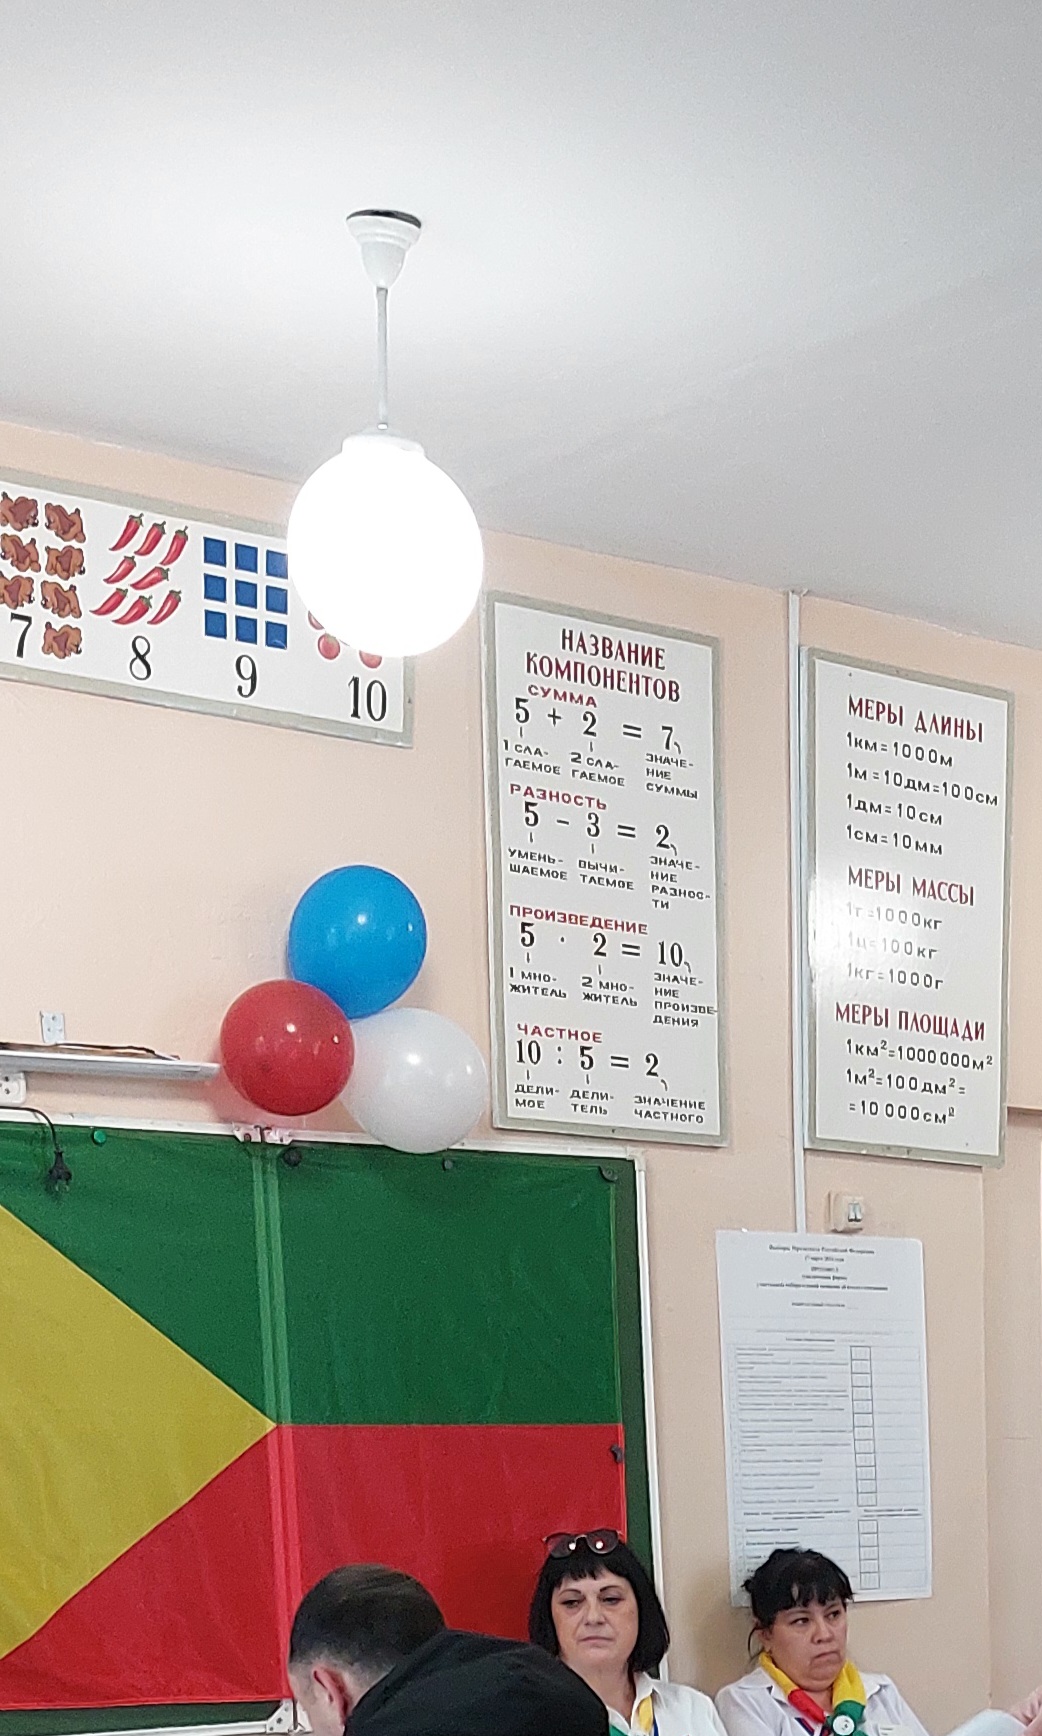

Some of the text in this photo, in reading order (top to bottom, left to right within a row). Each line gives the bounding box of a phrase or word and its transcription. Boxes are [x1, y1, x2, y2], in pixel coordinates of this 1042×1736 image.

[10, 613, 33, 659] 7
[561, 628, 667, 670] НАЗВАНИЕ
[129, 636, 152, 680] 8
[234, 655, 258, 698] 9
[526, 651, 681, 702] КОМПОНЕНТОВ
[347, 676, 388, 722] 10
[527, 684, 598, 708] СУММА
[515, 697, 530, 724] 5
[582, 711, 597, 737] 2
[661, 725, 674, 750] 7
[848, 694, 983, 743] МЕРЫ ДЛИНЫ
[503, 739, 509, 751] 1
[504, 757, 561, 775] ГАЕМОЕ
[570, 752, 582, 764] 2
[645, 753, 694, 769] ЗНАЧЕ-
[571, 769, 625, 787] ГАЕМОЕ
[646, 768, 672, 780] НИЕ
[509, 783, 607, 810] РАЗНОСТЬ
[645, 782, 698, 800] СУММЫ
[524, 801, 539, 827] 5
[586, 812, 601, 838] 3
[655, 824, 671, 849] 2
[508, 847, 563, 864] УМЕНЬ-
[649, 856, 700, 871] ЗНАЧЕ-
[509, 863, 568, 881] ШАЕМОЕ
[650, 871, 678, 883] НИЕ
[579, 874, 634, 890] ТАЕМОЕ
[848, 865, 974, 906] МЕРЫ МАССЫ
[651, 885, 710, 900] РАЗНОС-
[651, 899, 669, 910] ТИ
[509, 904, 648, 935] ПРОИЗВЕДЕНИЕ
[520, 922, 535, 947] 5
[592, 933, 607, 957] 2
[658, 940, 683, 967] 10
[581, 976, 593, 988] 2
[653, 973, 703, 986] ЗНАЧЕ-
[509, 983, 567, 999] ЖИТЕЛЬ
[582, 991, 638, 1007] ЖИТЕЛЬ
[654, 988, 680, 998] НИЕ
[653, 1014, 699, 1028] ДЕНИЯ
[835, 1002, 985, 1042] МЕРЫ ПЛОЩАДИ
[517, 1023, 603, 1043] ЧАСТНОЕ
[516, 1039, 542, 1065] 10
[579, 1046, 594, 1070] 5
[645, 1053, 659, 1077] 2
[514, 1083, 560, 1096] ДЕЛИ-
[569, 1089, 614, 1101] ДЕЛИ-
[515, 1098, 545, 1109] МОЕ
[571, 1103, 608, 1115] ТЕЛЬ
[634, 1095, 706, 1111] ЗНАЧЕНИЕ
[634, 1109, 704, 1124] ЧАСТНОГО
